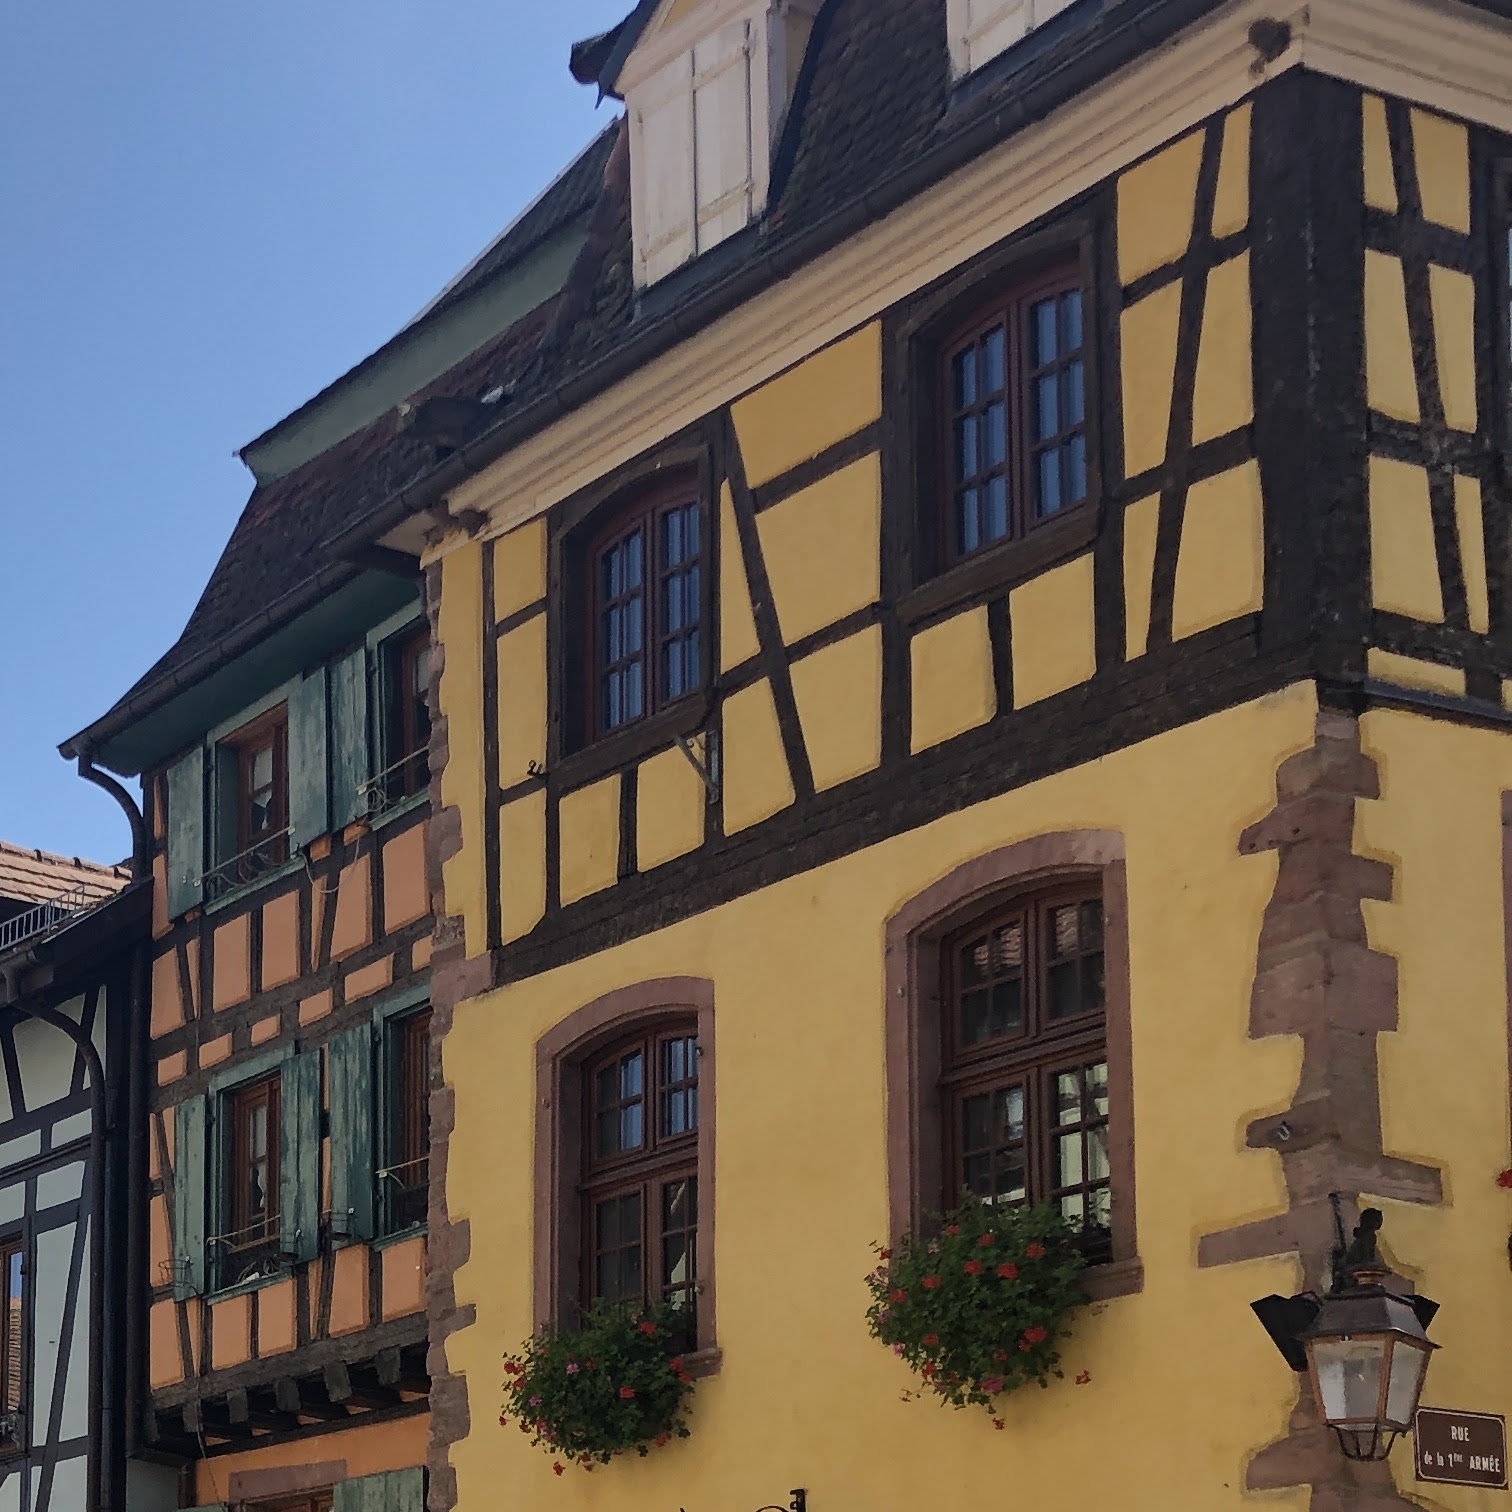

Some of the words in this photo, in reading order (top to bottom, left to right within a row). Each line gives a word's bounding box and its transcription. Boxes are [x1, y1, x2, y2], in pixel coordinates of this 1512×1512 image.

[1451, 1425, 1470, 1442] RUE
[1424, 1450, 1433, 1465] de
[1436, 1451, 1445, 1467] la
[1469, 1454, 1501, 1473] ARMÉE
